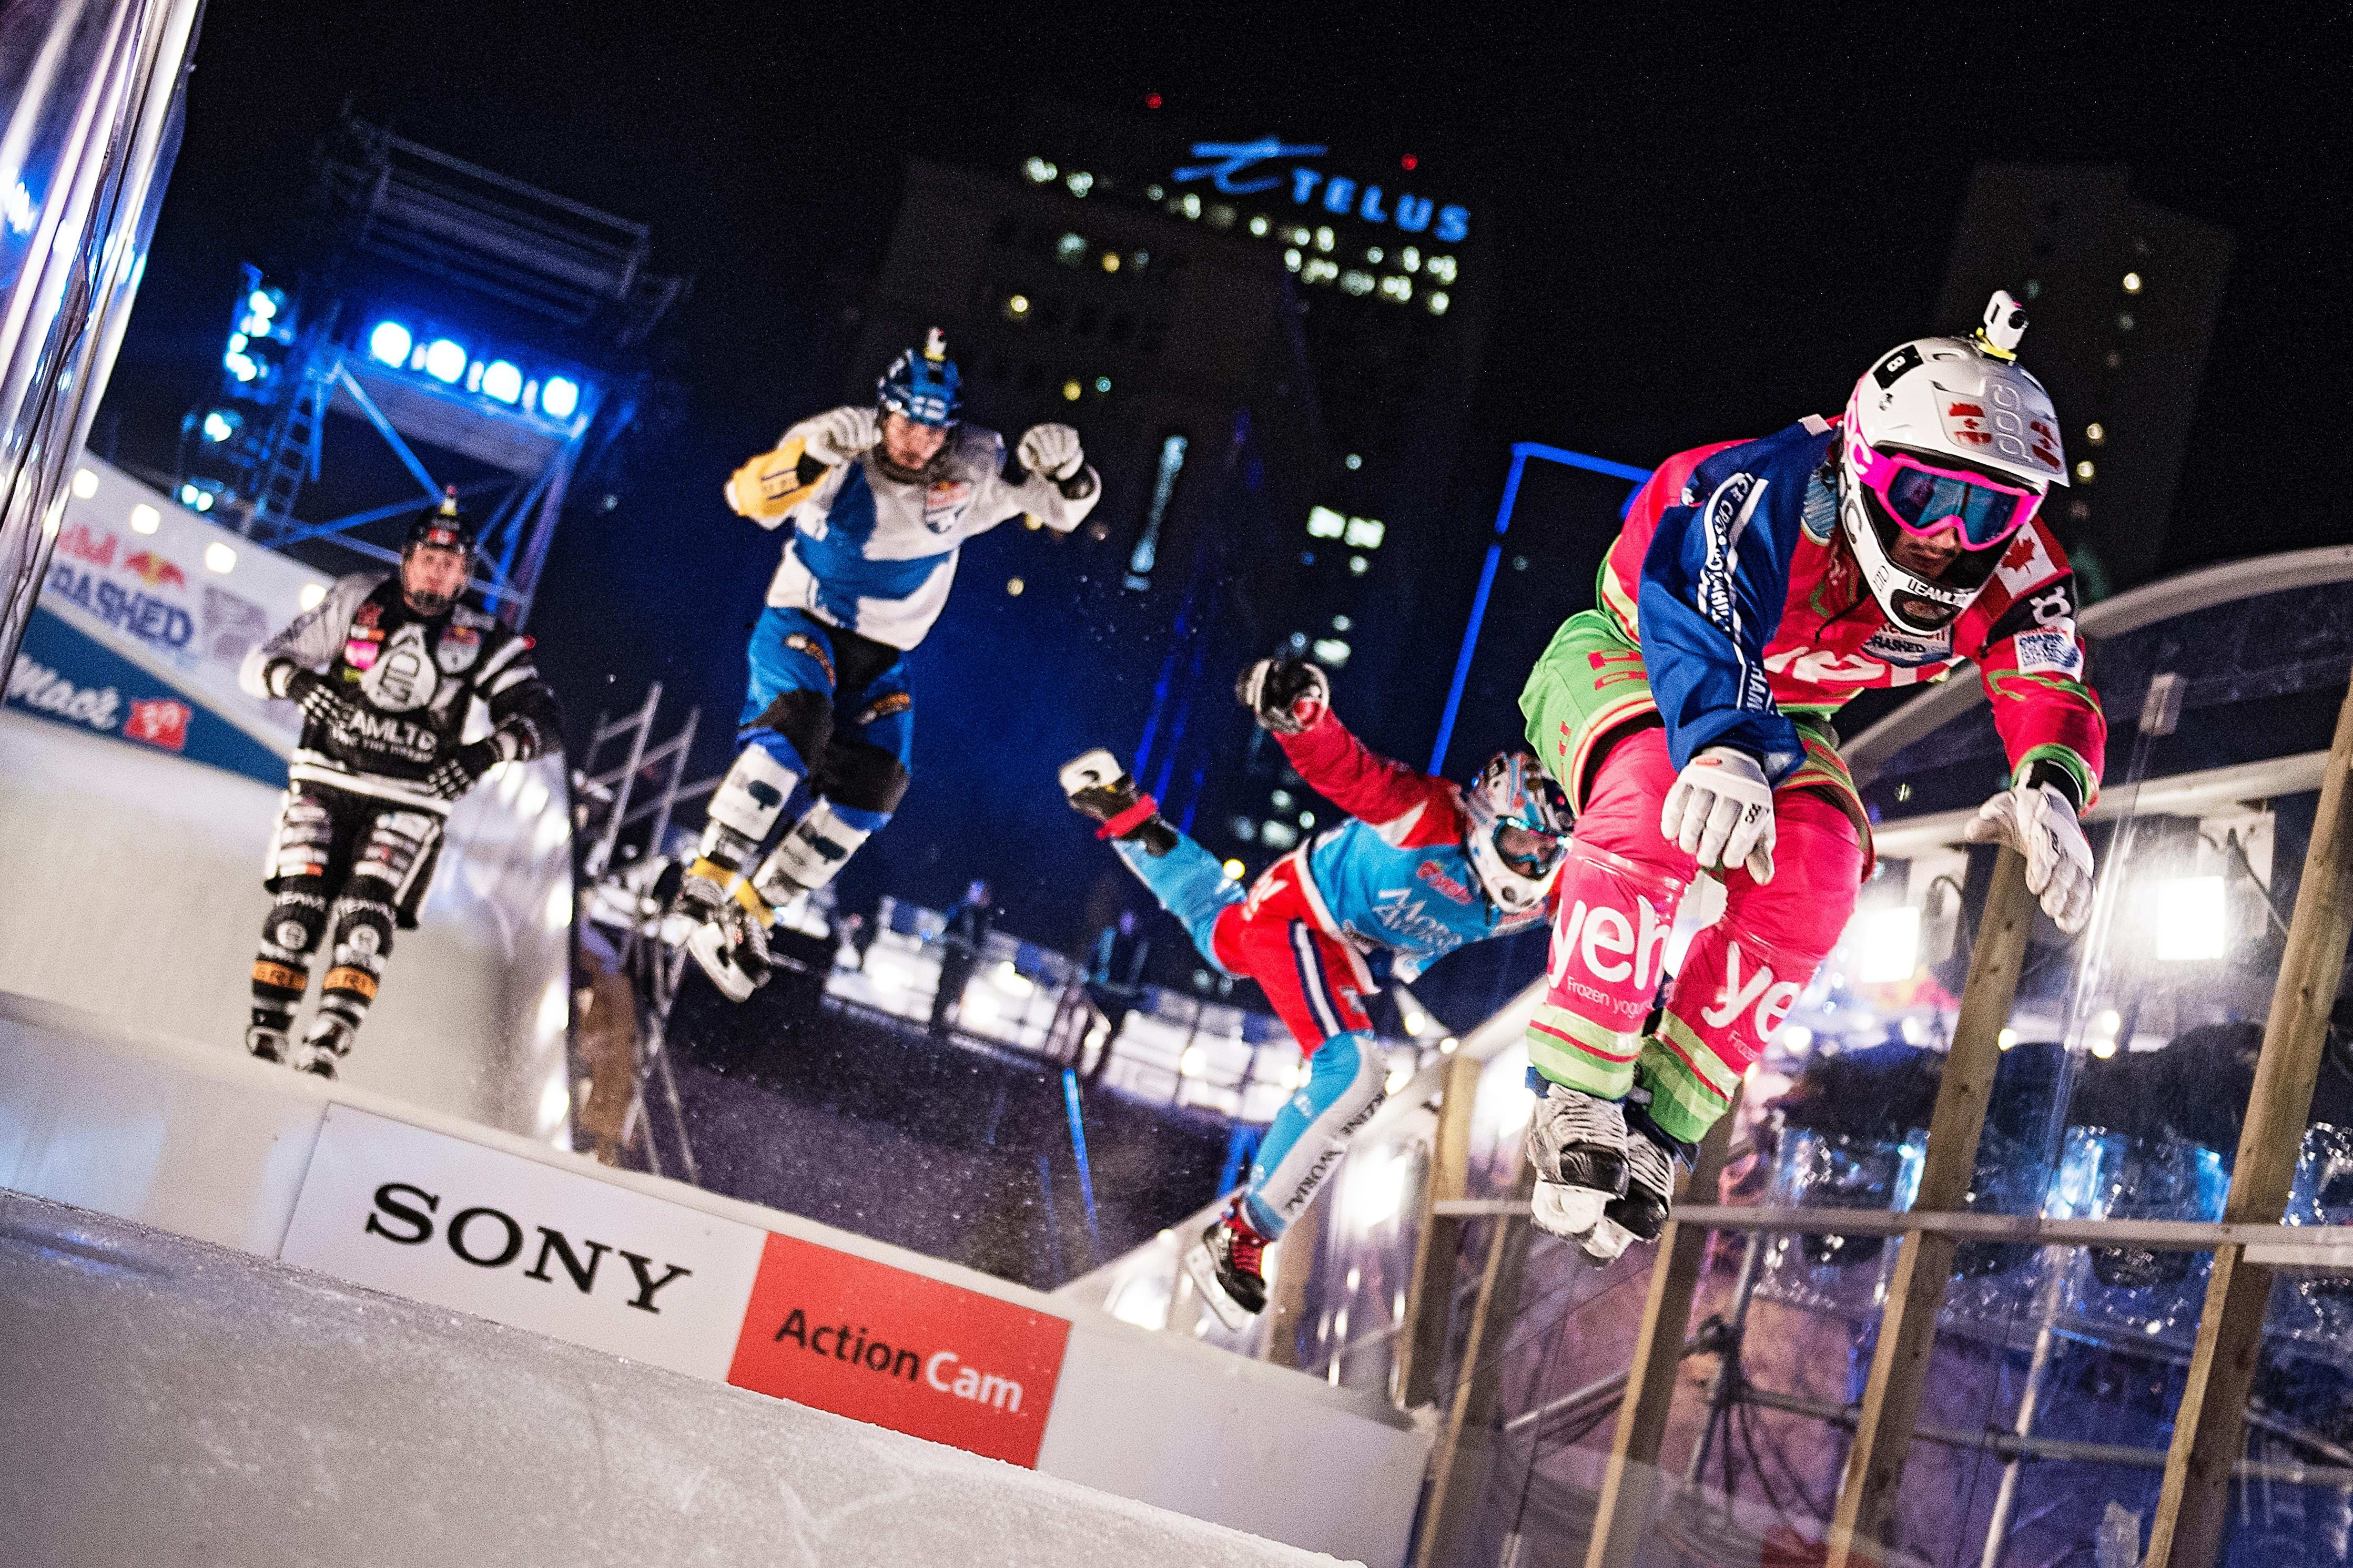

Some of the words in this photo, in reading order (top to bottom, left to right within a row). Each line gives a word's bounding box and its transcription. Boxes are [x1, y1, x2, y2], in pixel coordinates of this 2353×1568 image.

[1292, 167, 1470, 242] TELUS
[49, 563, 194, 649] RASHED
[1567, 977, 1610, 1009] Frozen
[1611, 993, 1655, 1019] yogur
[1701, 941, 1801, 1044] ye
[365, 1182, 693, 1314] SONY
[774, 1308, 921, 1381] Action
[926, 1352, 1023, 1413] Cam
